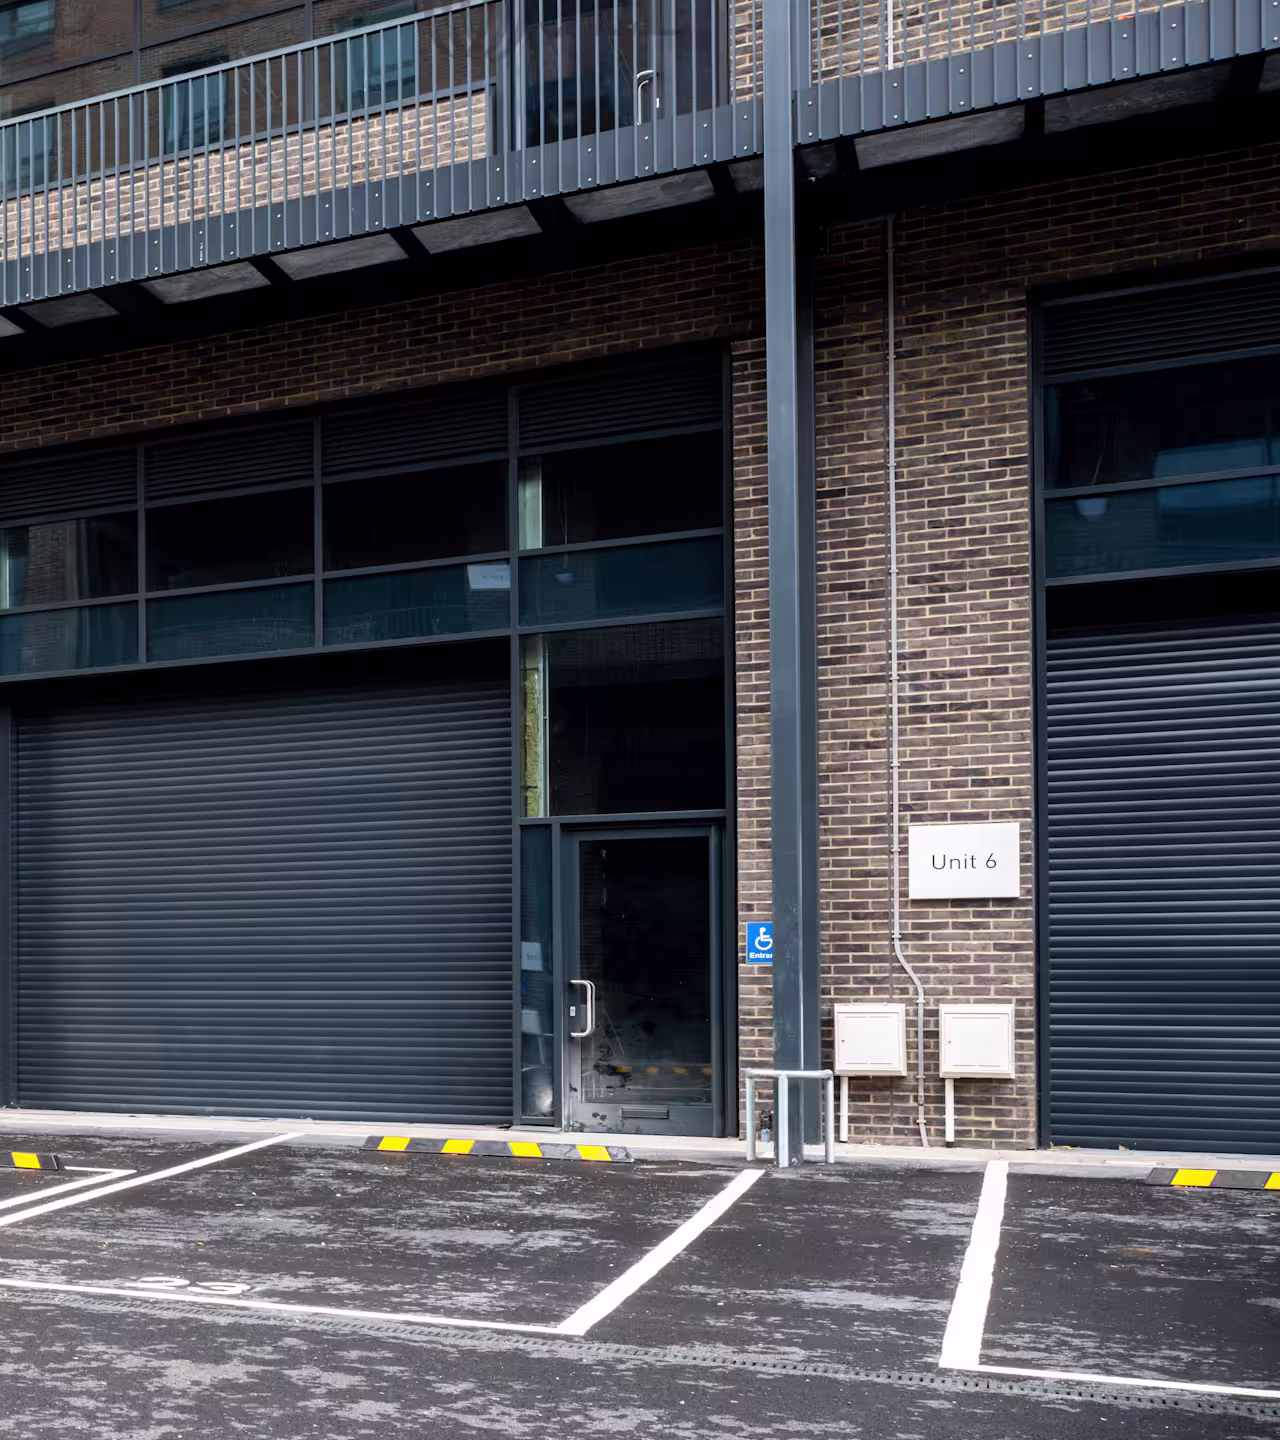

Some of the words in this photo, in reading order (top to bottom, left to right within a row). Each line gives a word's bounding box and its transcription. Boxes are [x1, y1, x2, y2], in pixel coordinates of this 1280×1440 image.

[931, 853, 977, 870] Unit
[985, 852, 997, 869] 6
[125, 1276, 251, 1295] 23
